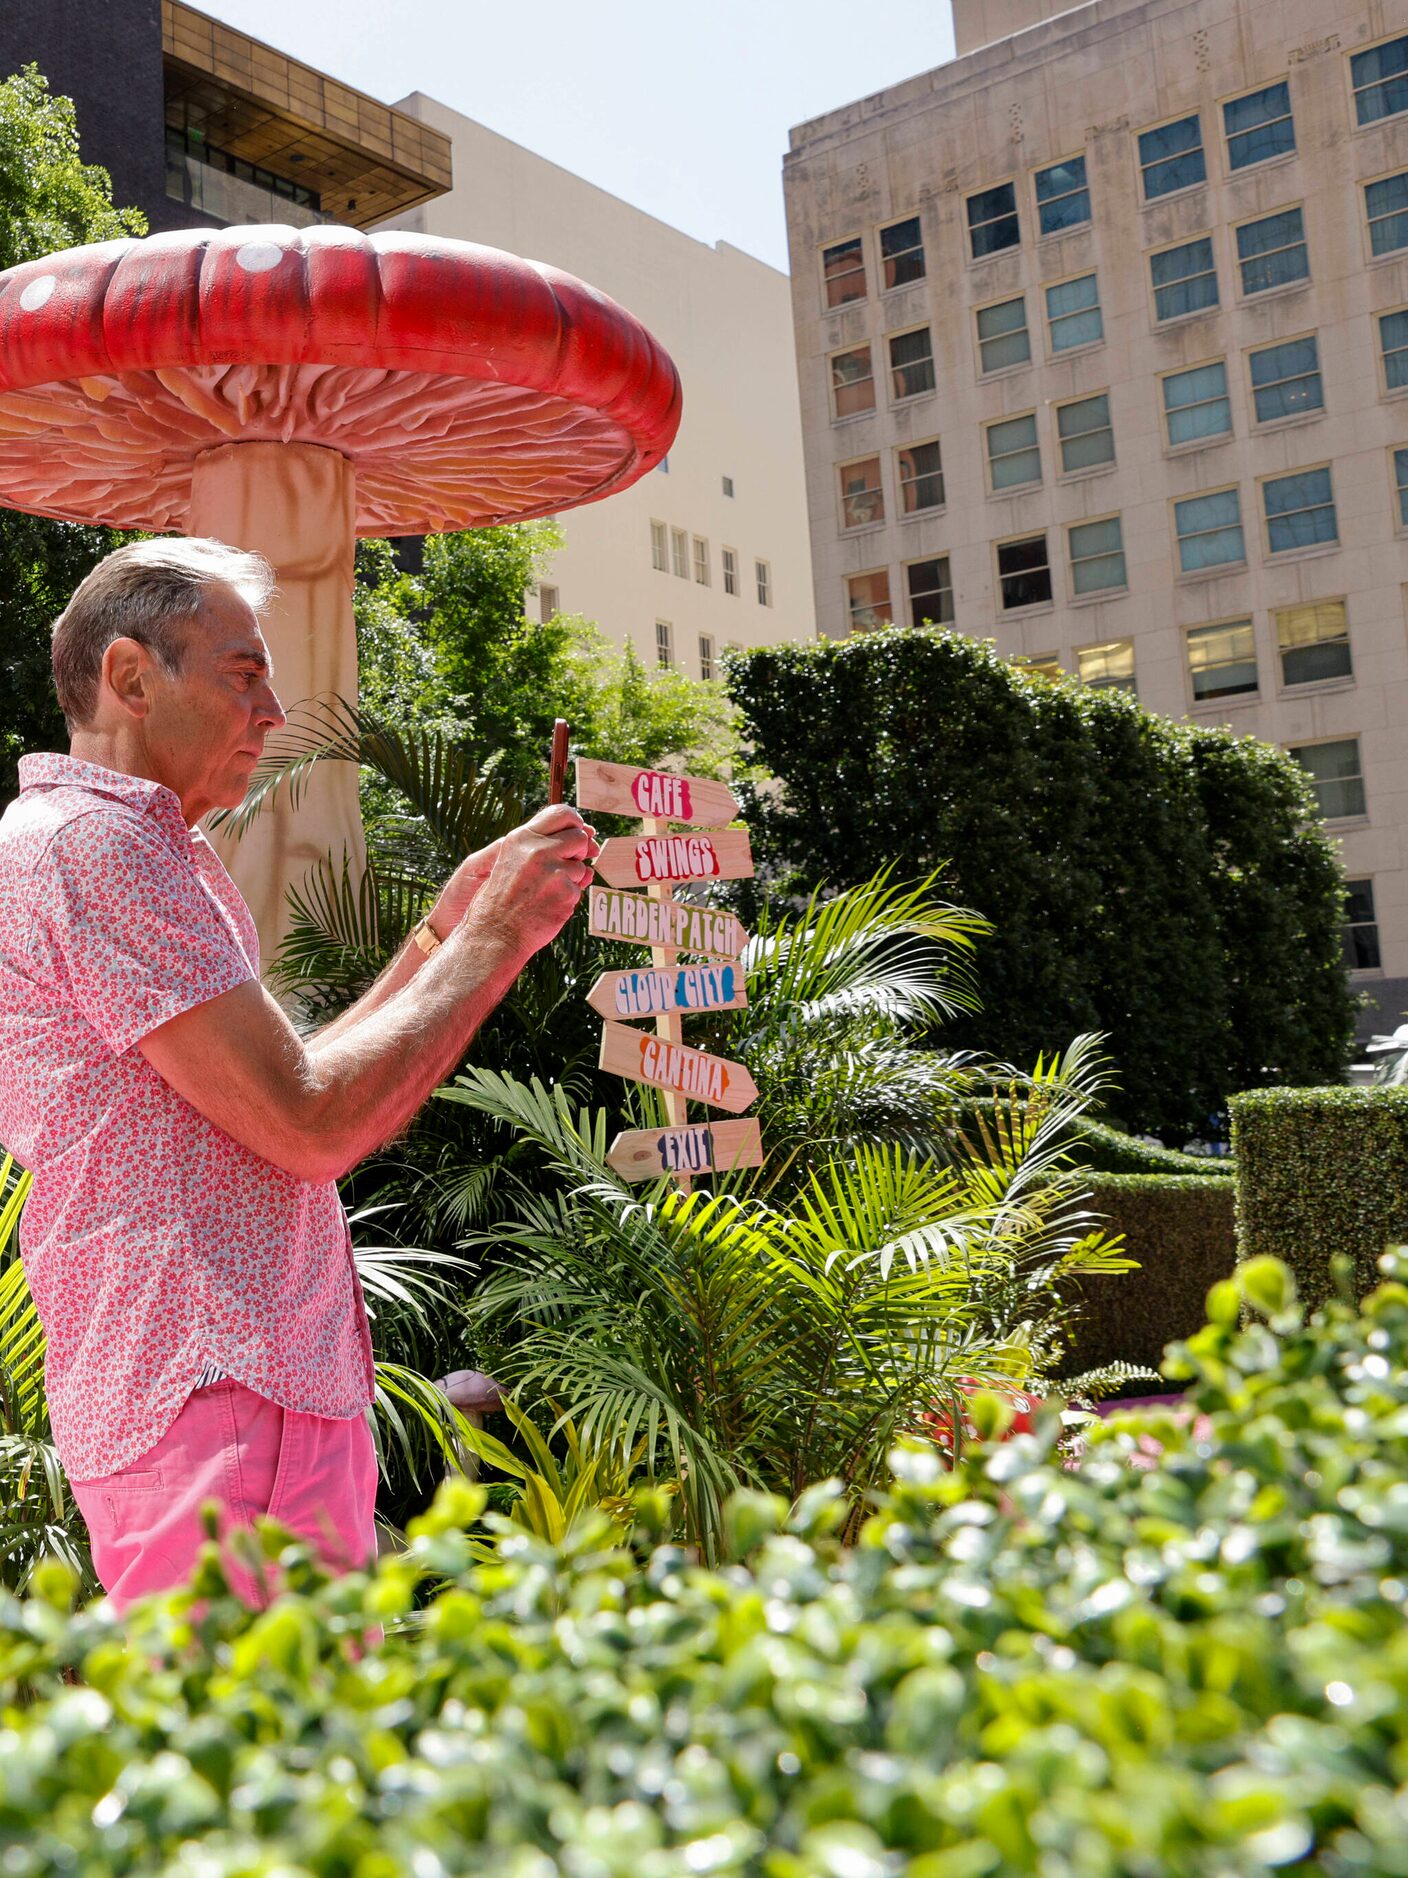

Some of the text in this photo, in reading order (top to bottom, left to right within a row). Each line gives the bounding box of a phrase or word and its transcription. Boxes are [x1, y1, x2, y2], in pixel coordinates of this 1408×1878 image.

[638, 774, 683, 817] CAFÉ
[637, 837, 714, 879] SWINGS
[594, 892, 737, 955] GARDEN PATCH
[615, 967, 726, 1014] CLOUD CITY
[643, 1040, 723, 1101] CANTINA
[665, 1128, 710, 1170] EXIT
